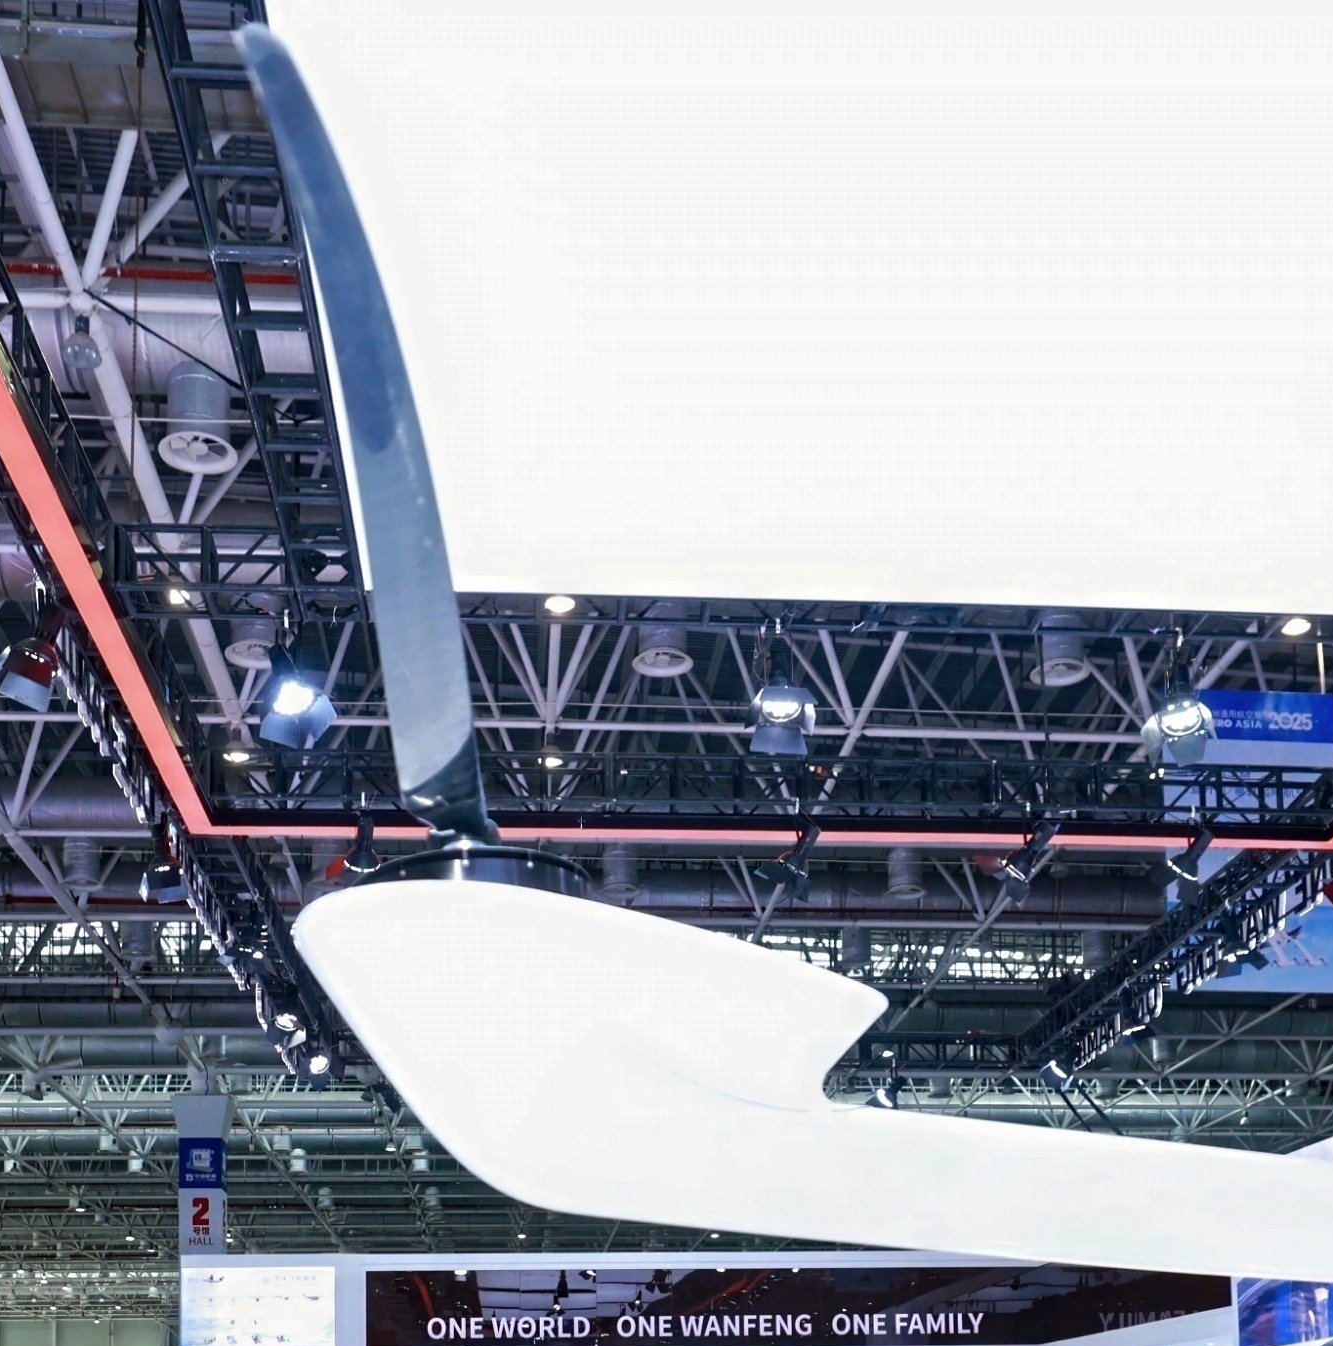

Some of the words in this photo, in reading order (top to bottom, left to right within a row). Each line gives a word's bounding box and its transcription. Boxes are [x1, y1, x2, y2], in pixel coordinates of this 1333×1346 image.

[1235, 720, 1262, 729] ASIA
[1268, 712, 1313, 731] 2025
[192, 1197, 209, 1226] 2
[193, 1227, 209, 1236] 号馆
[426, 1315, 484, 1341] ONE
[492, 1315, 591, 1340] WORLD
[616, 1314, 673, 1339] ONE
[681, 1312, 813, 1339] WANFENG
[831, 1311, 889, 1337] ONE
[895, 1311, 984, 1336] FAMILY
